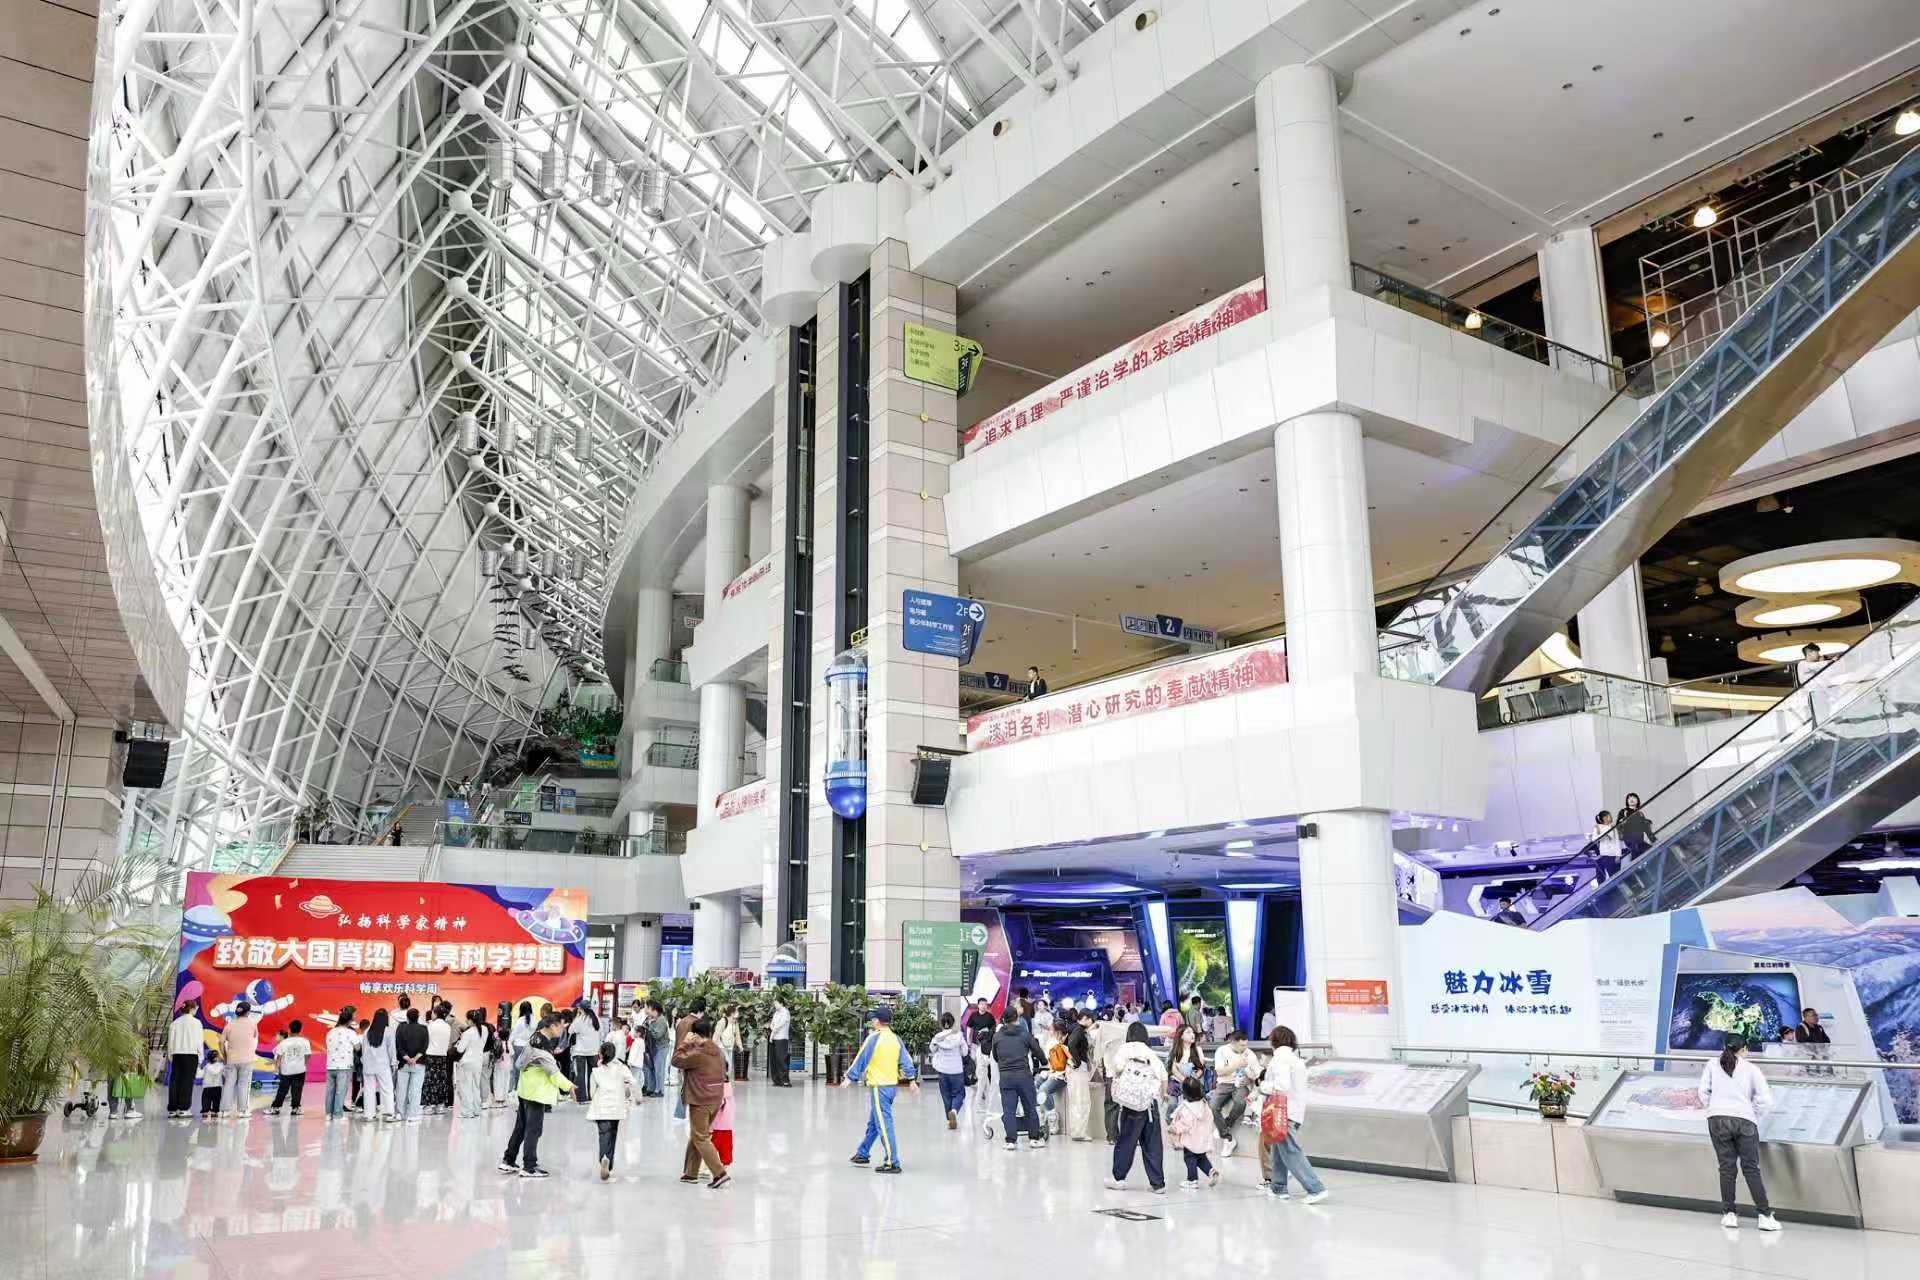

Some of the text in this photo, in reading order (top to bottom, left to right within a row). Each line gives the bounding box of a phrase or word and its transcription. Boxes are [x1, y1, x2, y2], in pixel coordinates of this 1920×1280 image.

[953, 340, 966, 352] 3F
[984, 308, 1234, 446] 追求真理 严谨治学的求实精神
[956, 603, 969, 617] 2F
[963, 624, 972, 636] 2F
[989, 663, 1255, 742] 淡泊名利 潜心研究的奉献精神
[338, 913, 467, 931] 弘扬科学家精神
[406, 943, 564, 972] 点亮科学梦想
[360, 981, 438, 995] 畅享欢乐科学周
[1444, 969, 1552, 995] 魅力冰雪
